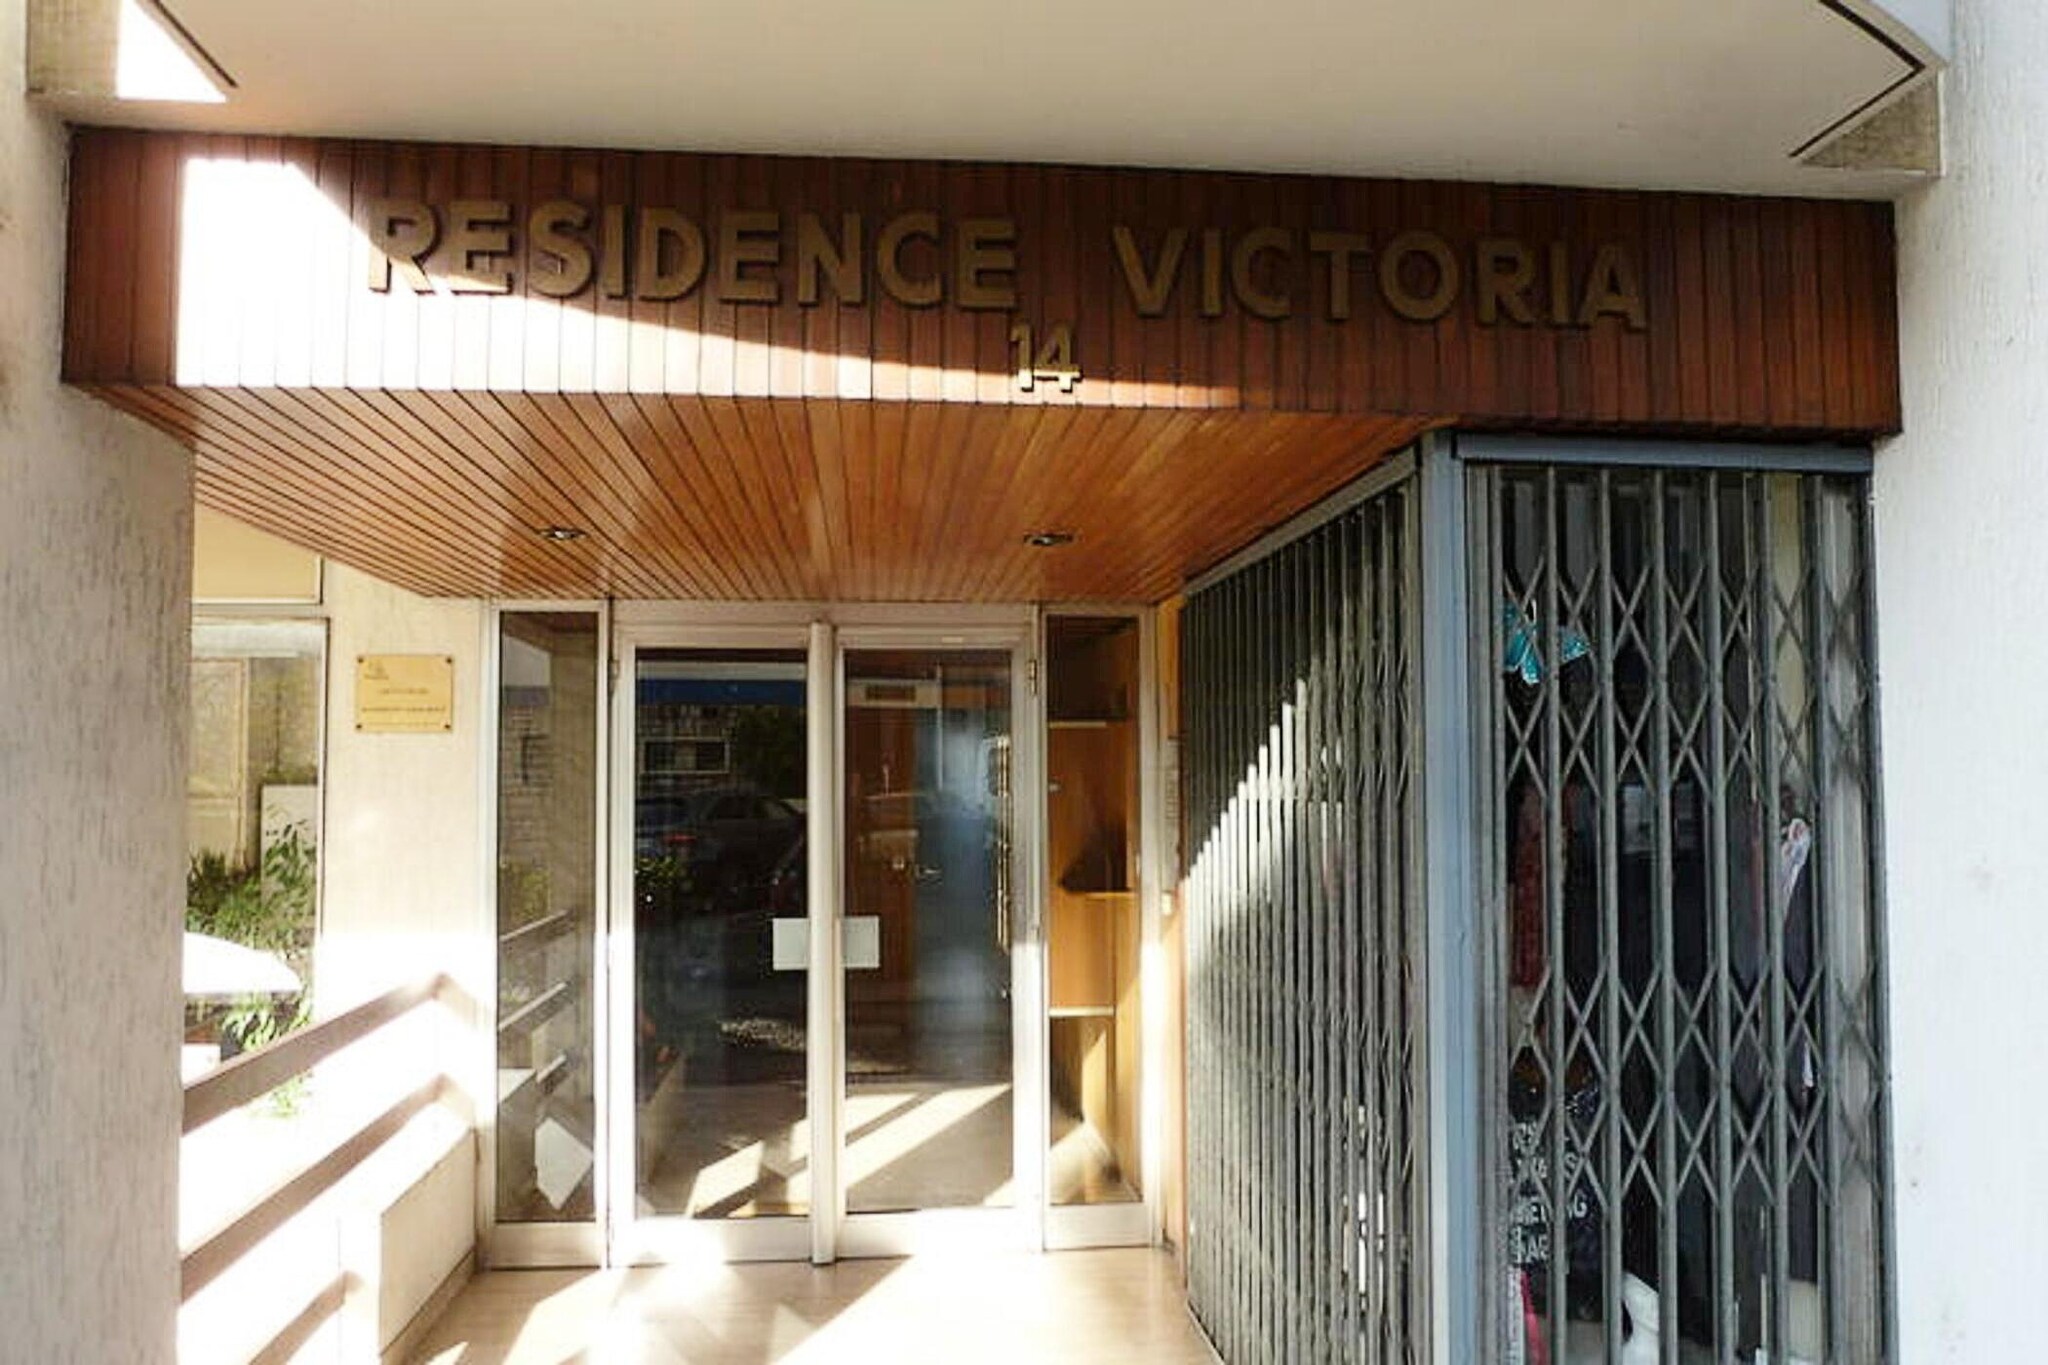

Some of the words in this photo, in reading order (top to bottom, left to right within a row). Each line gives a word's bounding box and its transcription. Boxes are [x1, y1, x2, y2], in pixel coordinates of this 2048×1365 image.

[368, 199, 1017, 309] RESIDENCE
[1111, 226, 1648, 331] VICTORIA
[1010, 322, 1083, 393] 14
